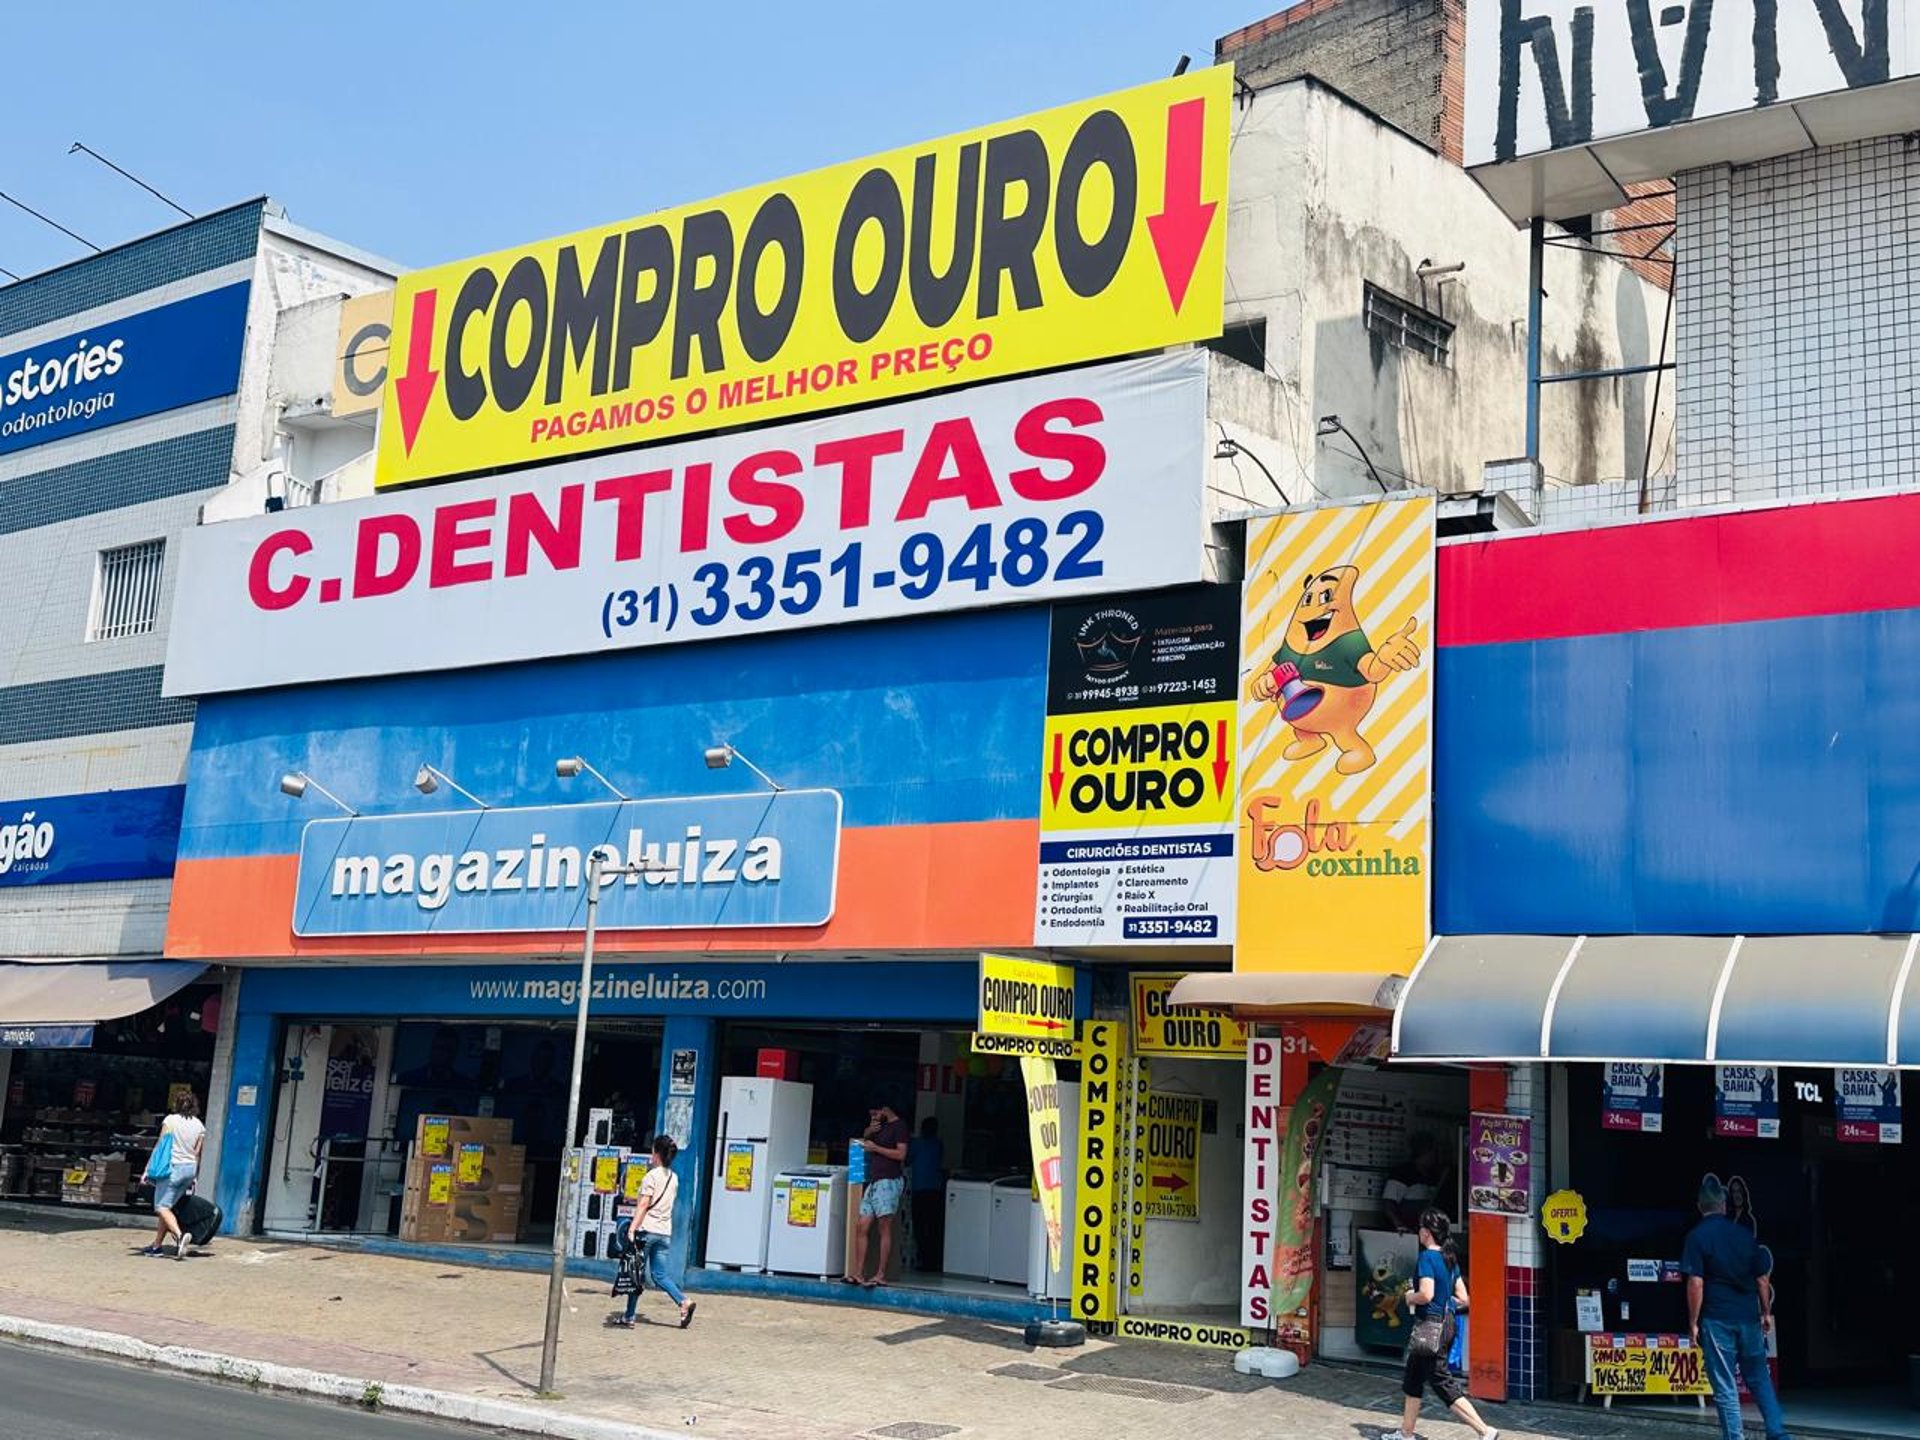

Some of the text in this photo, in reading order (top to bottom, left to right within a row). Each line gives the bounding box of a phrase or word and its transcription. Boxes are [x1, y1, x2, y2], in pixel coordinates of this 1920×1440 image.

[445, 109, 1137, 420] COMPRO OURO
[7, 339, 124, 402] stories
[530, 333, 993, 443] PAGAMOS O MELHOR PREÇO
[2, 392, 115, 437] odontologia
[248, 398, 1106, 611] C.DENTISTAS
[602, 509, 1105, 638] (31) 3351-9482
[1078, 609, 1139, 636] INK THRONED
[1157, 678, 1216, 693] 97223-1453
[1069, 720, 1209, 767] COMPRO
[1070, 767, 1204, 813] OURO
[1067, 842, 1212, 859] CIRURGIÕES DENTISTAS
[1306, 849, 1421, 877] coxinha
[331, 826, 782, 909] magazineluiza
[1052, 867, 1111, 878] Odontologia
[1125, 865, 1164, 875] Estética
[1051, 880, 1099, 892] Implantes
[1125, 877, 1188, 887] Clareamento
[1125, 890, 1155, 900] Raio X
[1051, 893, 1093, 904] Cirurgias
[1051, 905, 1102, 915] Ortodontia
[1124, 902, 1208, 915] Reabilitação Oral
[1050, 918, 1105, 927] Endodontia
[1138, 920, 1212, 933] 3351-9482
[983, 977, 1073, 1020] COMPRO OURO
[975, 1036, 1073, 1056] COMPRO OURO
[1163, 1020, 1221, 1047] OURO
[328, 1059, 357, 1072] ser
[1612, 1062, 1643, 1074] CASAS
[1723, 1067, 1756, 1079] CASAS
[1842, 1070, 1877, 1084] CASAS
[1611, 1075, 1641, 1088] BAHIA
[1723, 1080, 1755, 1092] BAHIA
[1794, 1081, 1823, 1103] TCL
[1843, 1084, 1876, 1096] BAHIA
[1085, 1025, 1108, 1190] COMPRO
[1149, 1095, 1198, 1122] COMPRO
[1134, 1056, 1148, 1188] COMPRO
[1150, 1123, 1196, 1160] OURO
[1248, 1042, 1273, 1320] DENTISTAS
[1131, 1201, 1143, 1287] OURO
[1080, 1205, 1104, 1317] OURO
[1124, 1320, 1192, 1340] COMPRO
[1196, 1328, 1245, 1347] OURO
[1669, 1351, 1699, 1385] 208
